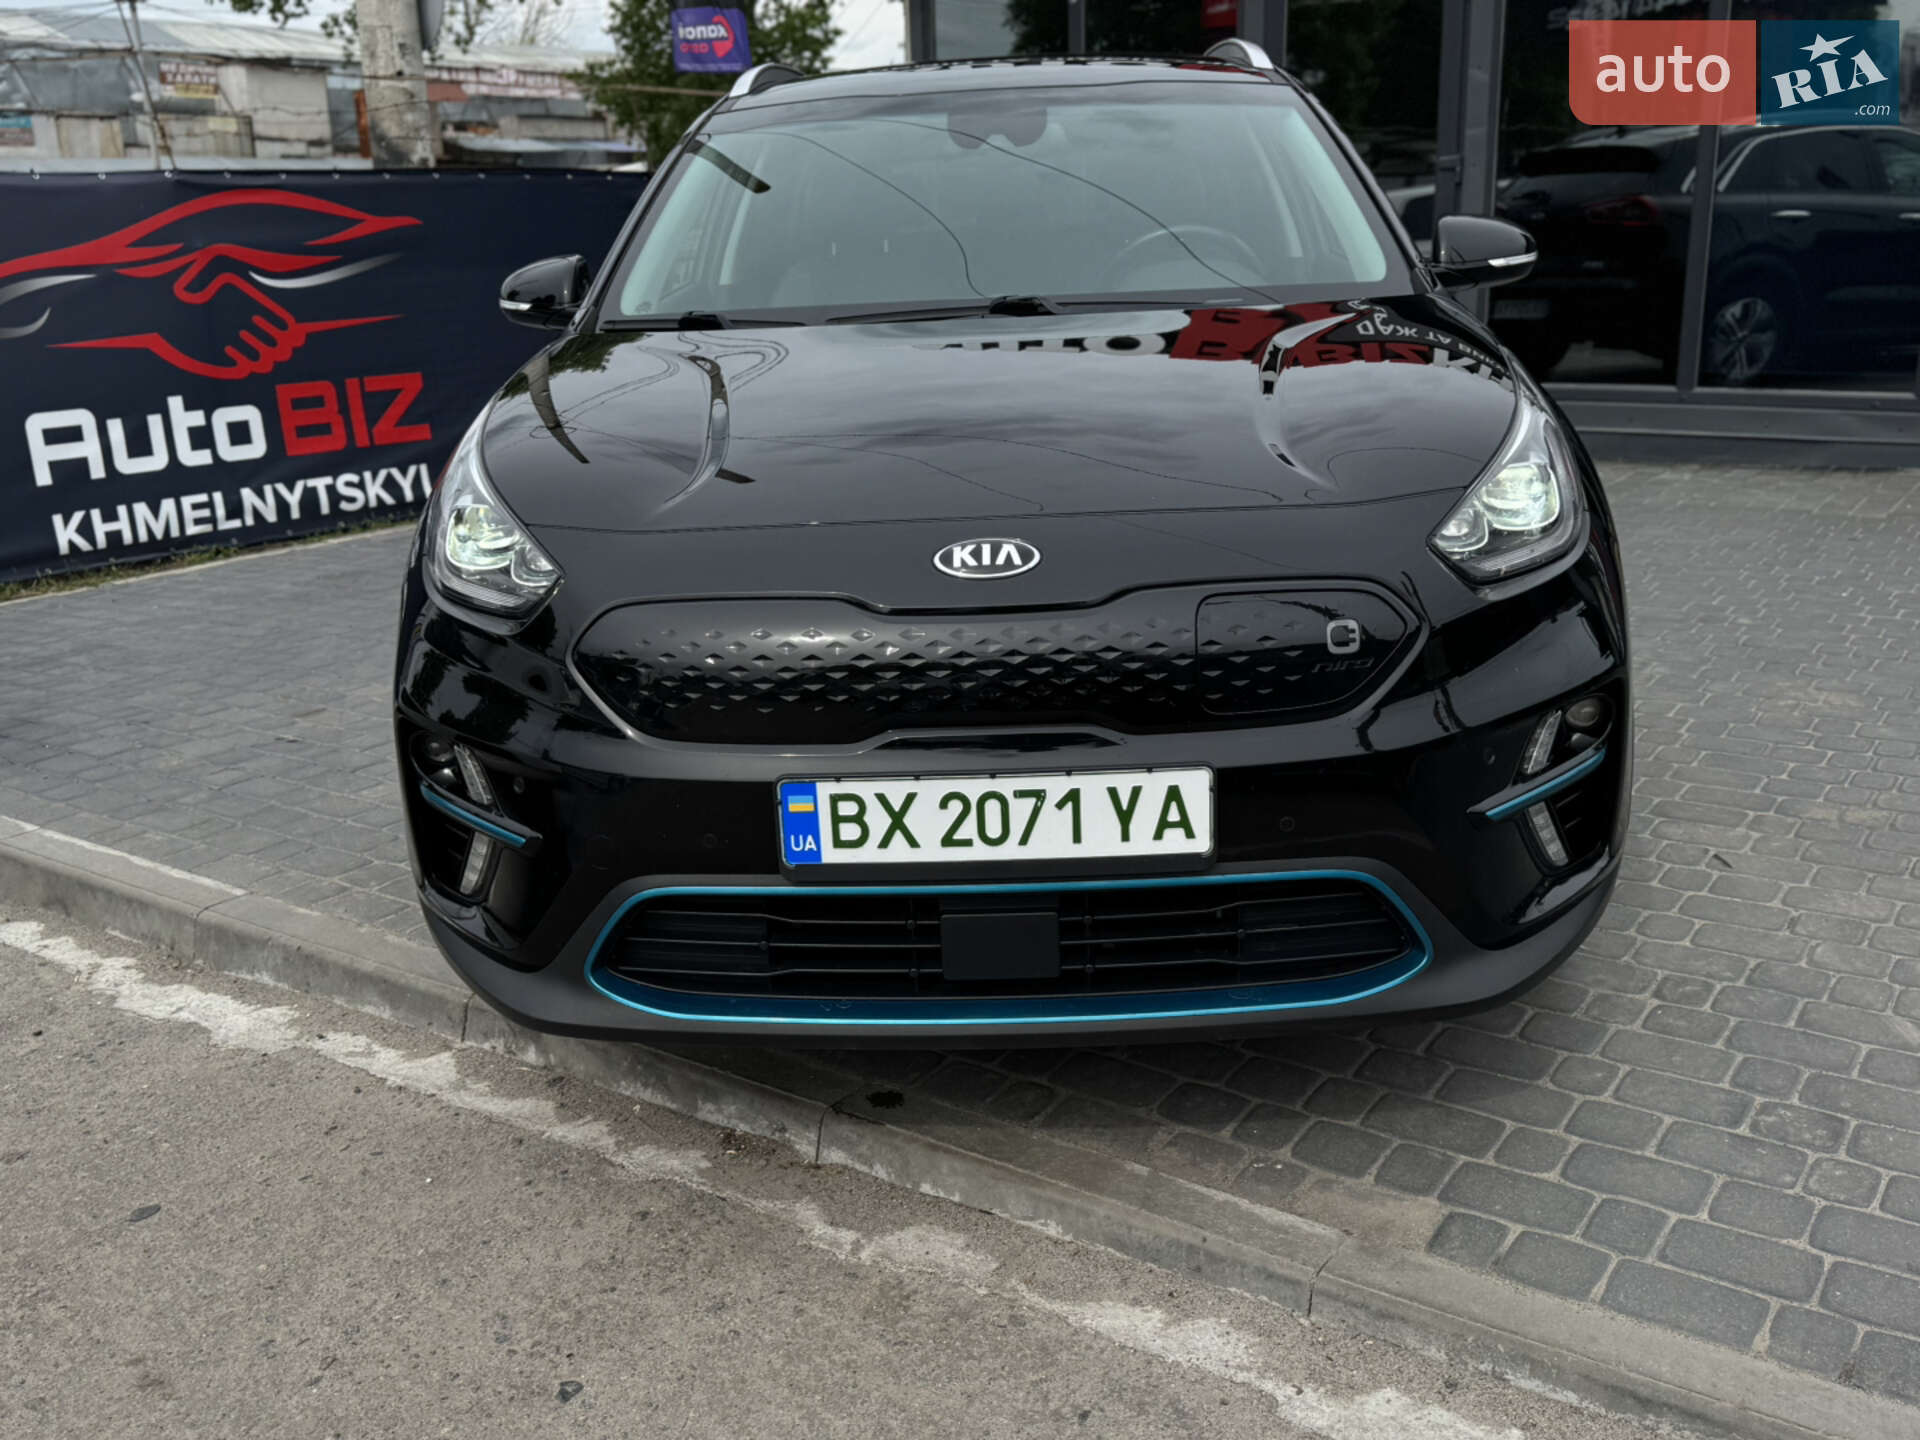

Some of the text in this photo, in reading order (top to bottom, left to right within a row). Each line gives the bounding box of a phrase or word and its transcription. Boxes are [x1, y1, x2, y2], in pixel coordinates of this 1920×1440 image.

[52, 463, 432, 556] KHMELNYTSKYI
[952, 543, 1023, 568] KIA
[829, 784, 1196, 849] BX 2071 YA
[791, 834, 817, 852] UA
